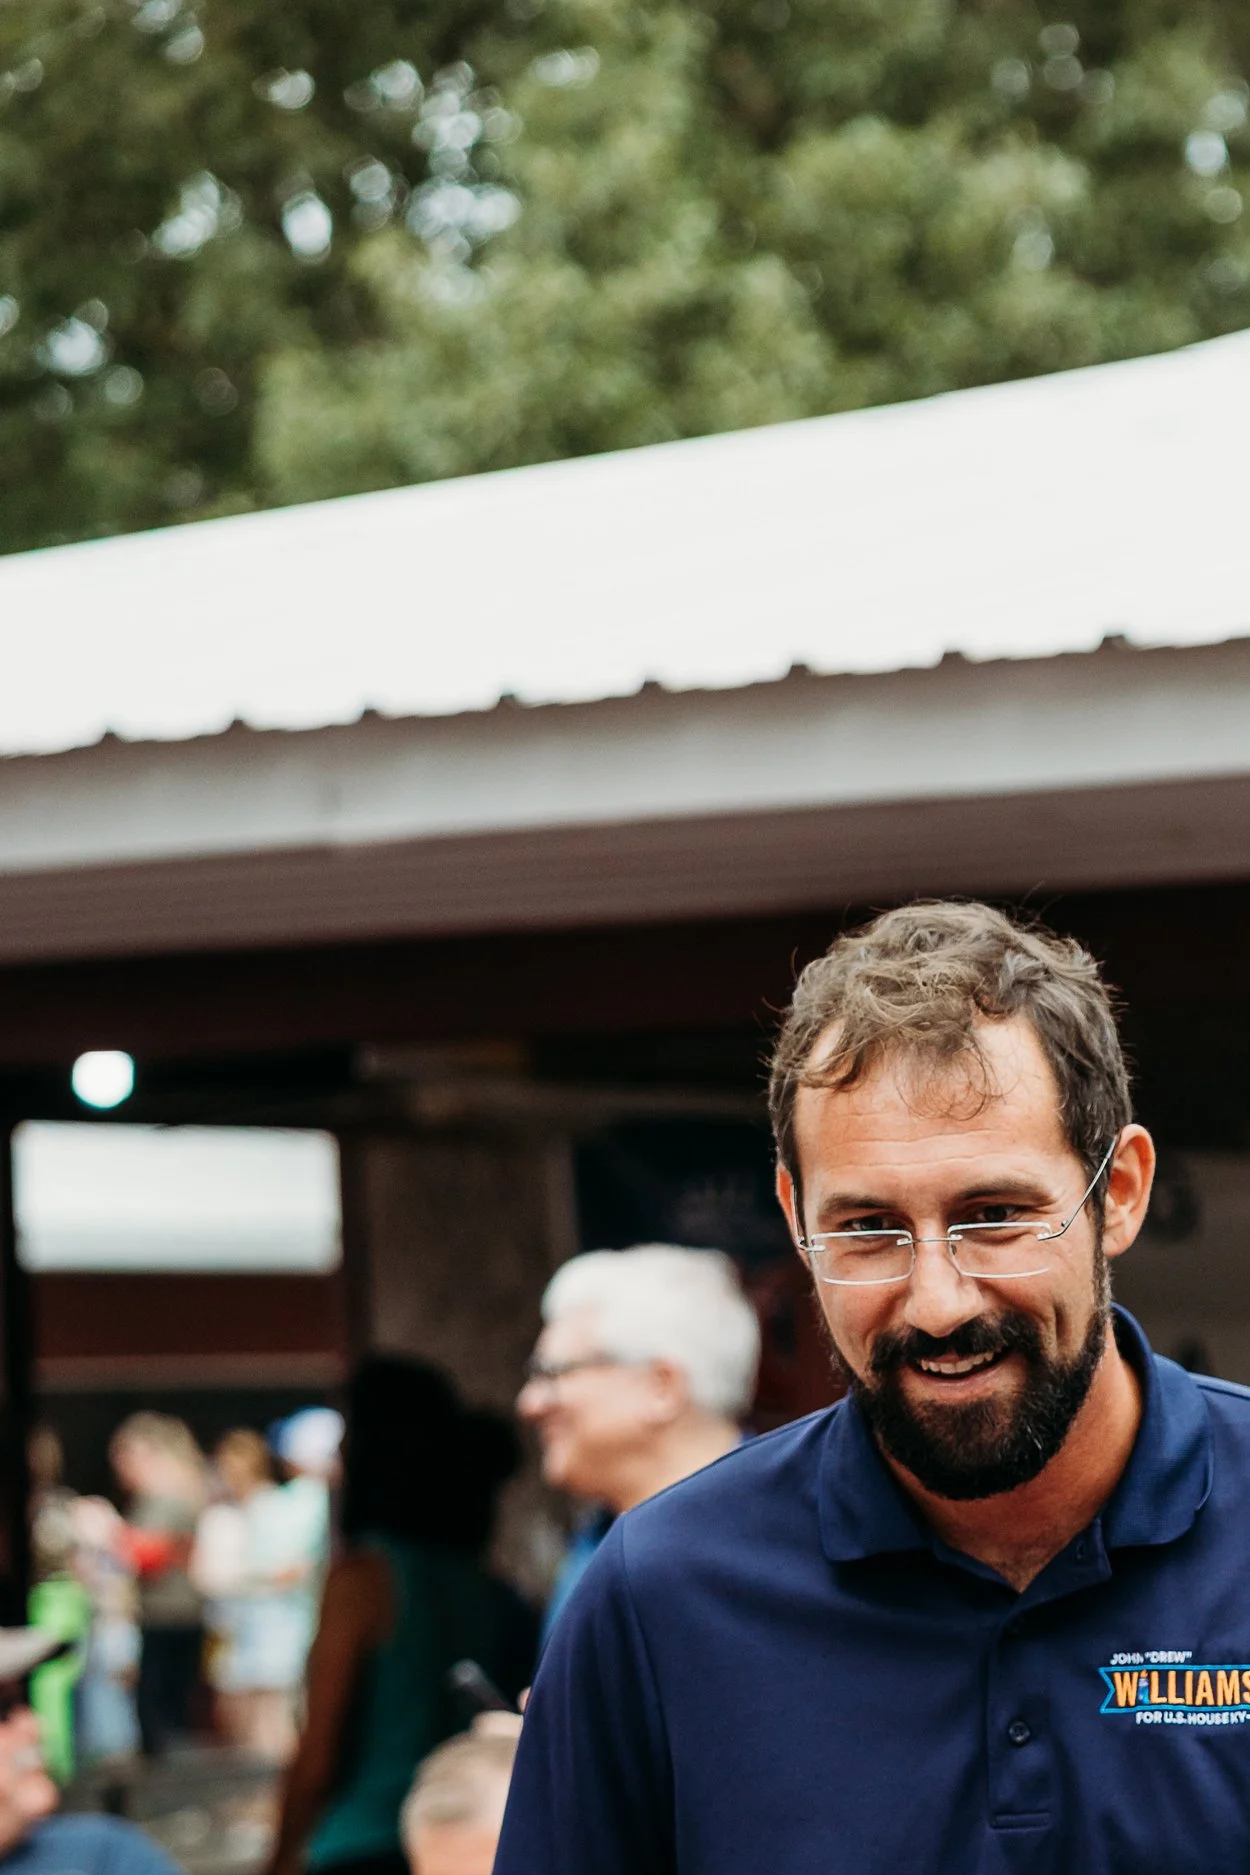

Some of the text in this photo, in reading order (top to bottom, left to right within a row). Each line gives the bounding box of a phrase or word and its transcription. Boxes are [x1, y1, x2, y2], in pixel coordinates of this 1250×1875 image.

[1110, 1652, 1144, 1665] JOHN
[1135, 1711, 1162, 1724] FOR
[1163, 1711, 1187, 1724] U.S.
[1187, 1711, 1229, 1725] HOUSE
